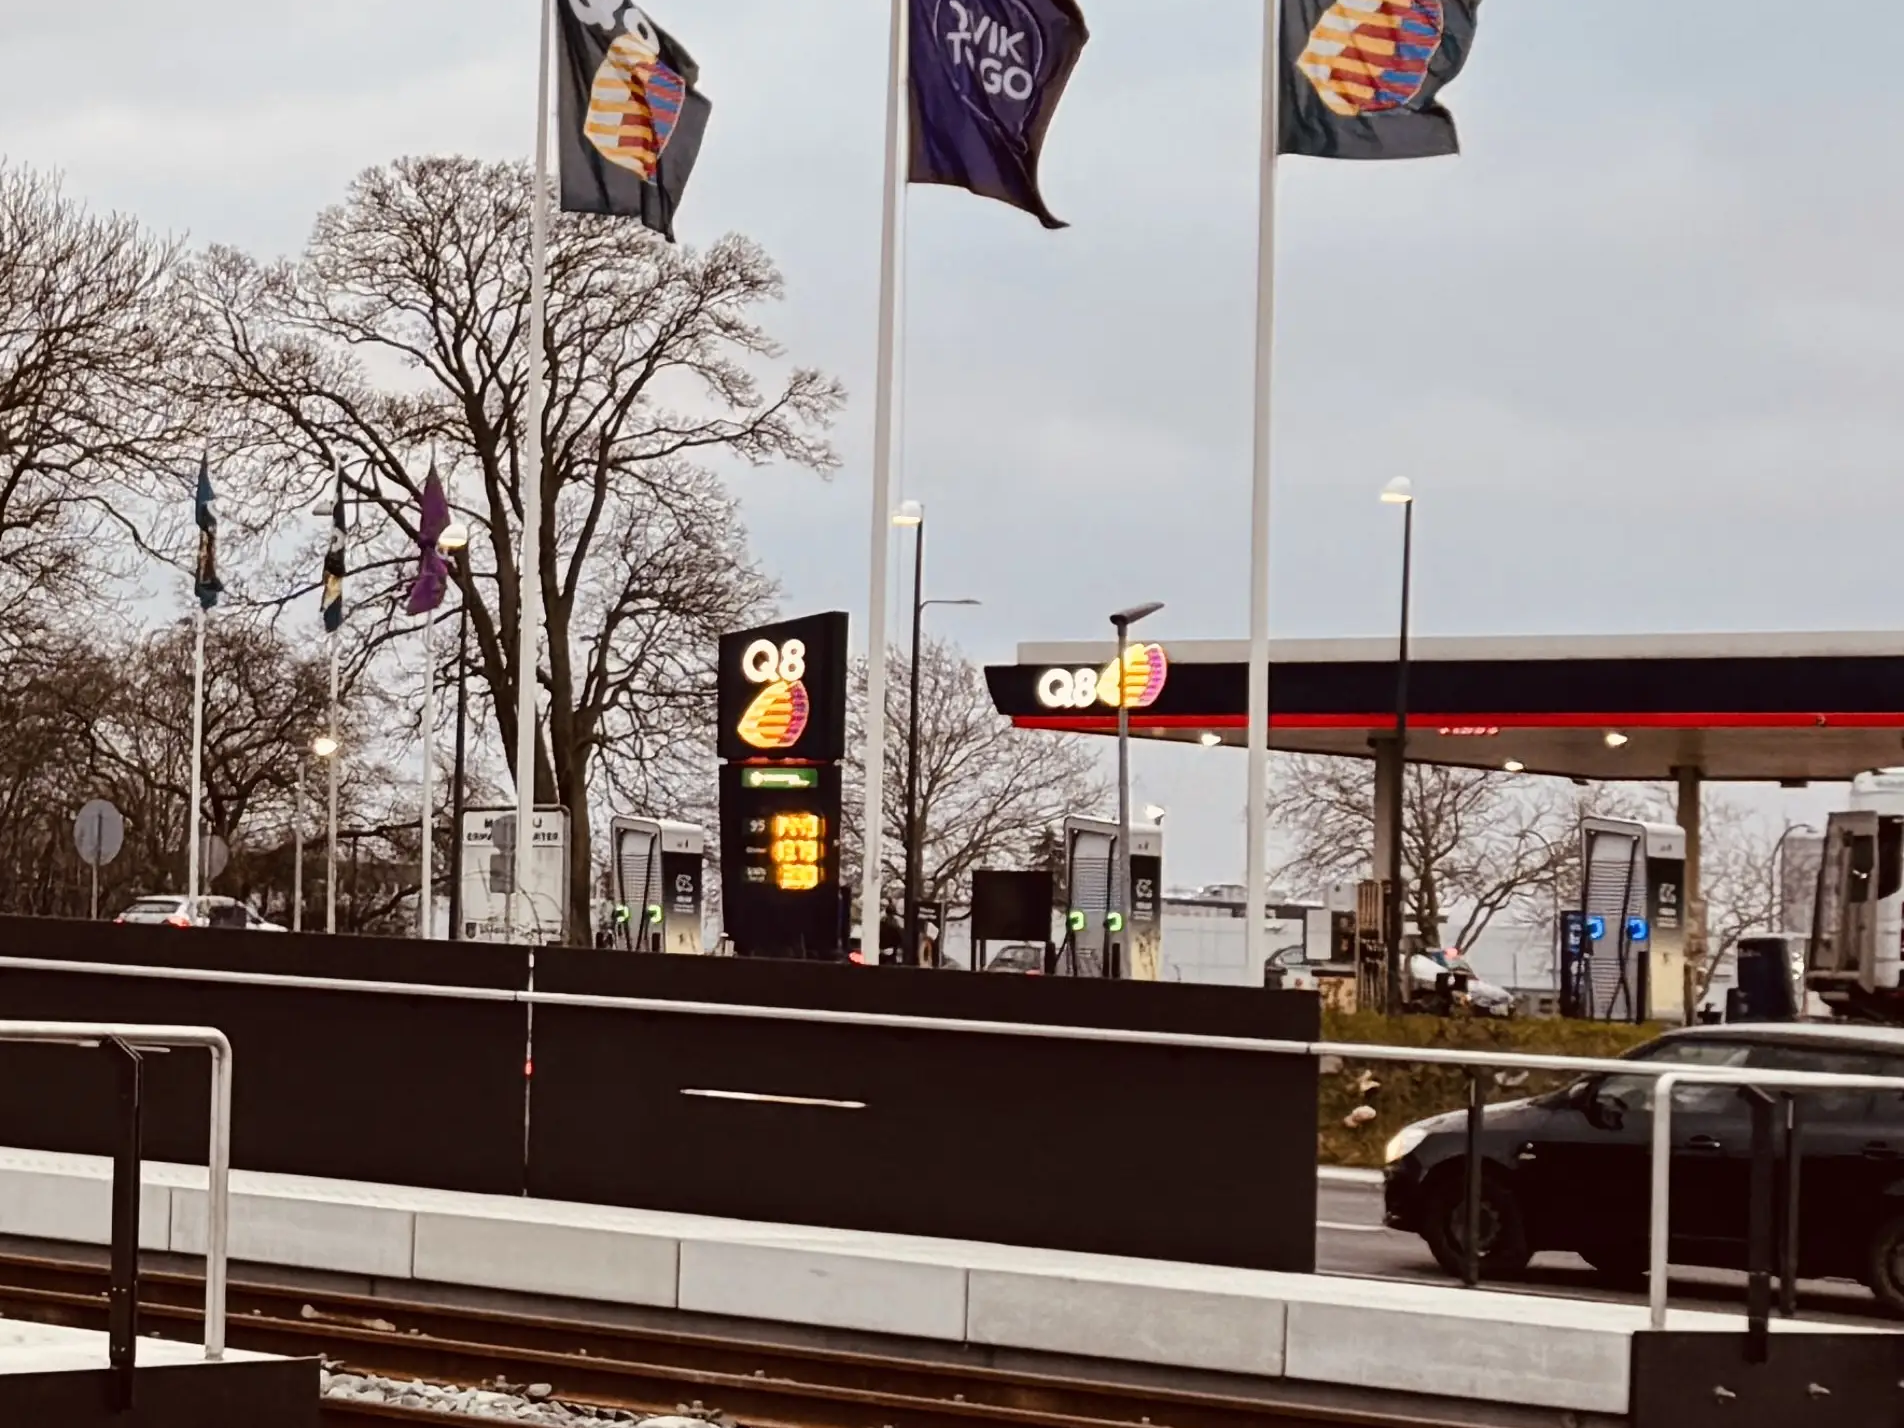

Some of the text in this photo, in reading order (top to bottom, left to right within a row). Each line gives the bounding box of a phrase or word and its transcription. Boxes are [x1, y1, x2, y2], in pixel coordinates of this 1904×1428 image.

[980, 58, 1033, 101] GO
[743, 638, 806, 683] Q8
[1038, 668, 1098, 708] Q8
